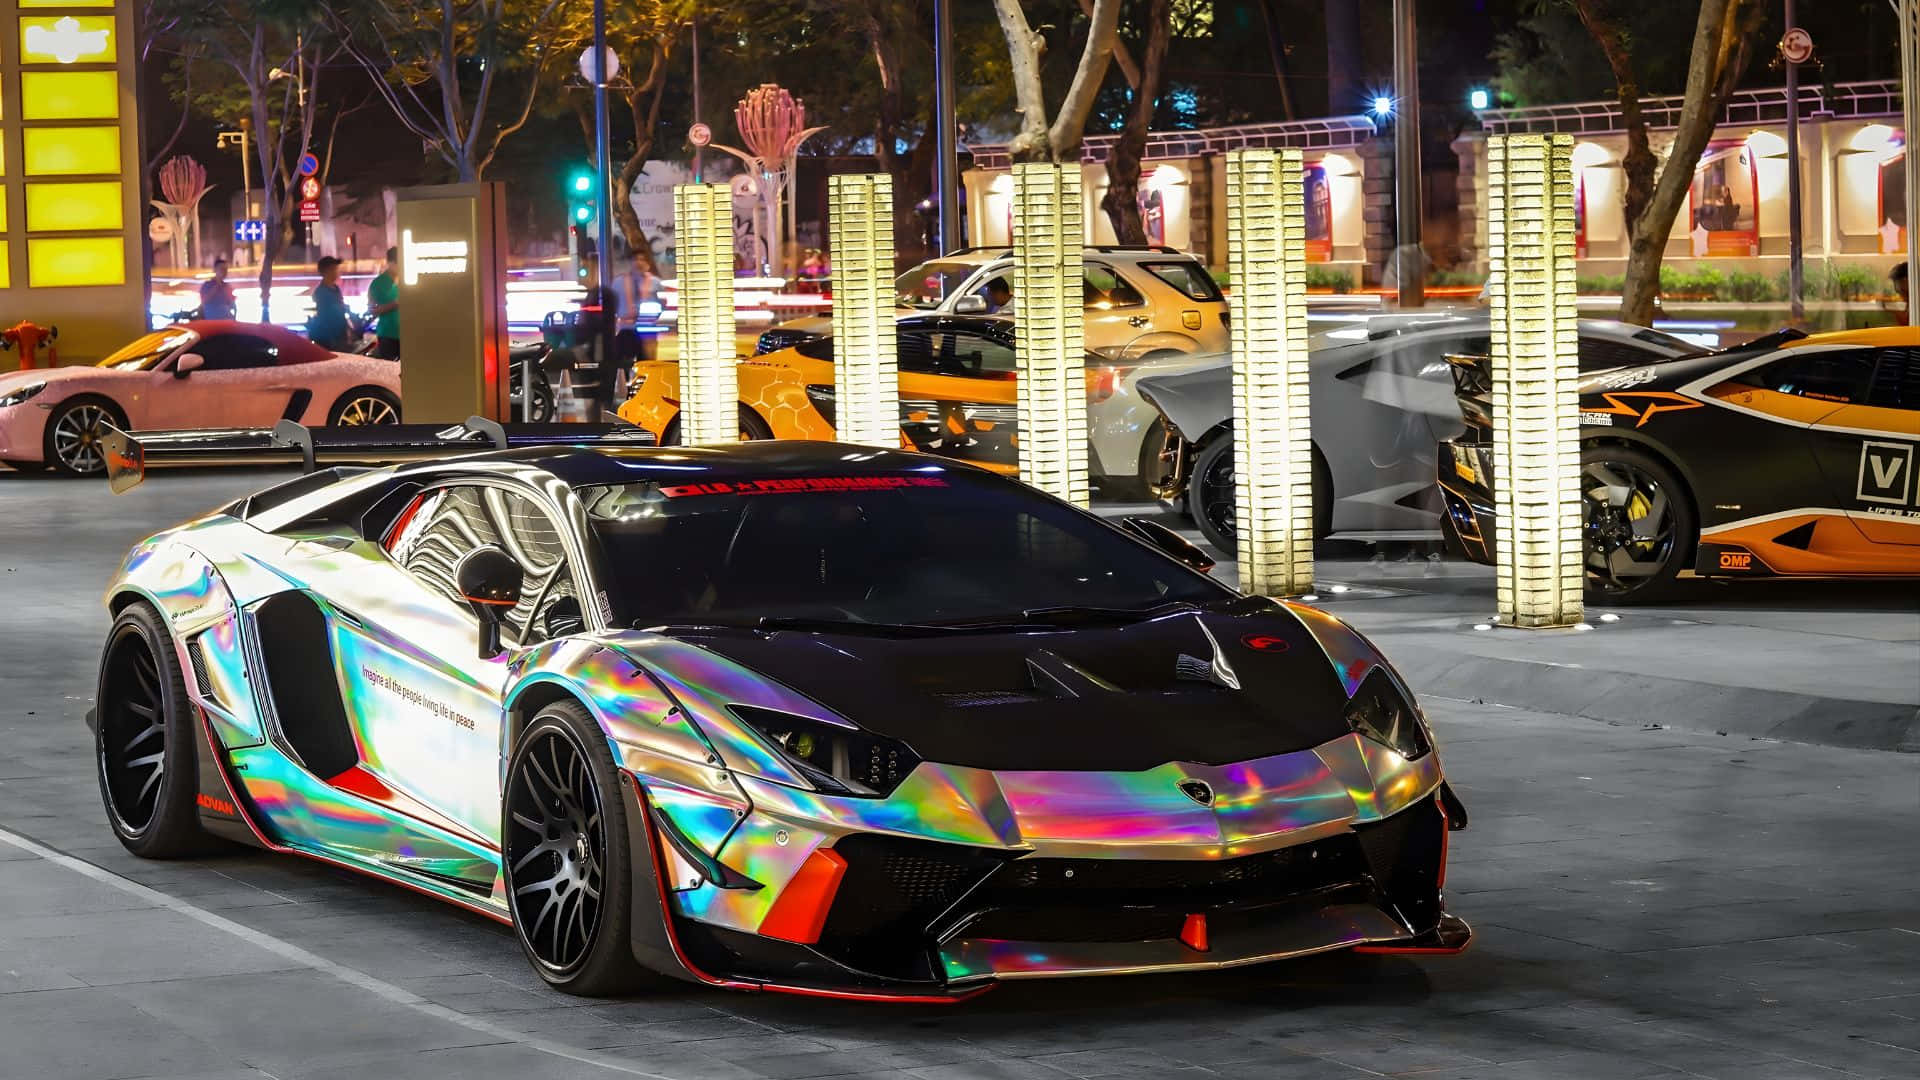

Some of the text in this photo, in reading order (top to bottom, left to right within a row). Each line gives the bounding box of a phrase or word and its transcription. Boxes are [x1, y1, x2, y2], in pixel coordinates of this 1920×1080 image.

[1870, 454, 1904, 489] V
[1868, 507, 1904, 516] LIFE'S
[1720, 555, 1751, 566] OMP
[362, 664, 384, 686] Imagine
[392, 680, 402, 695] the
[402, 687, 422, 706] people
[423, 694, 439, 717] living
[440, 702, 449, 718] life
[450, 705, 456, 721] in
[456, 713, 476, 730] peace
[196, 793, 234, 815] ADVAN
